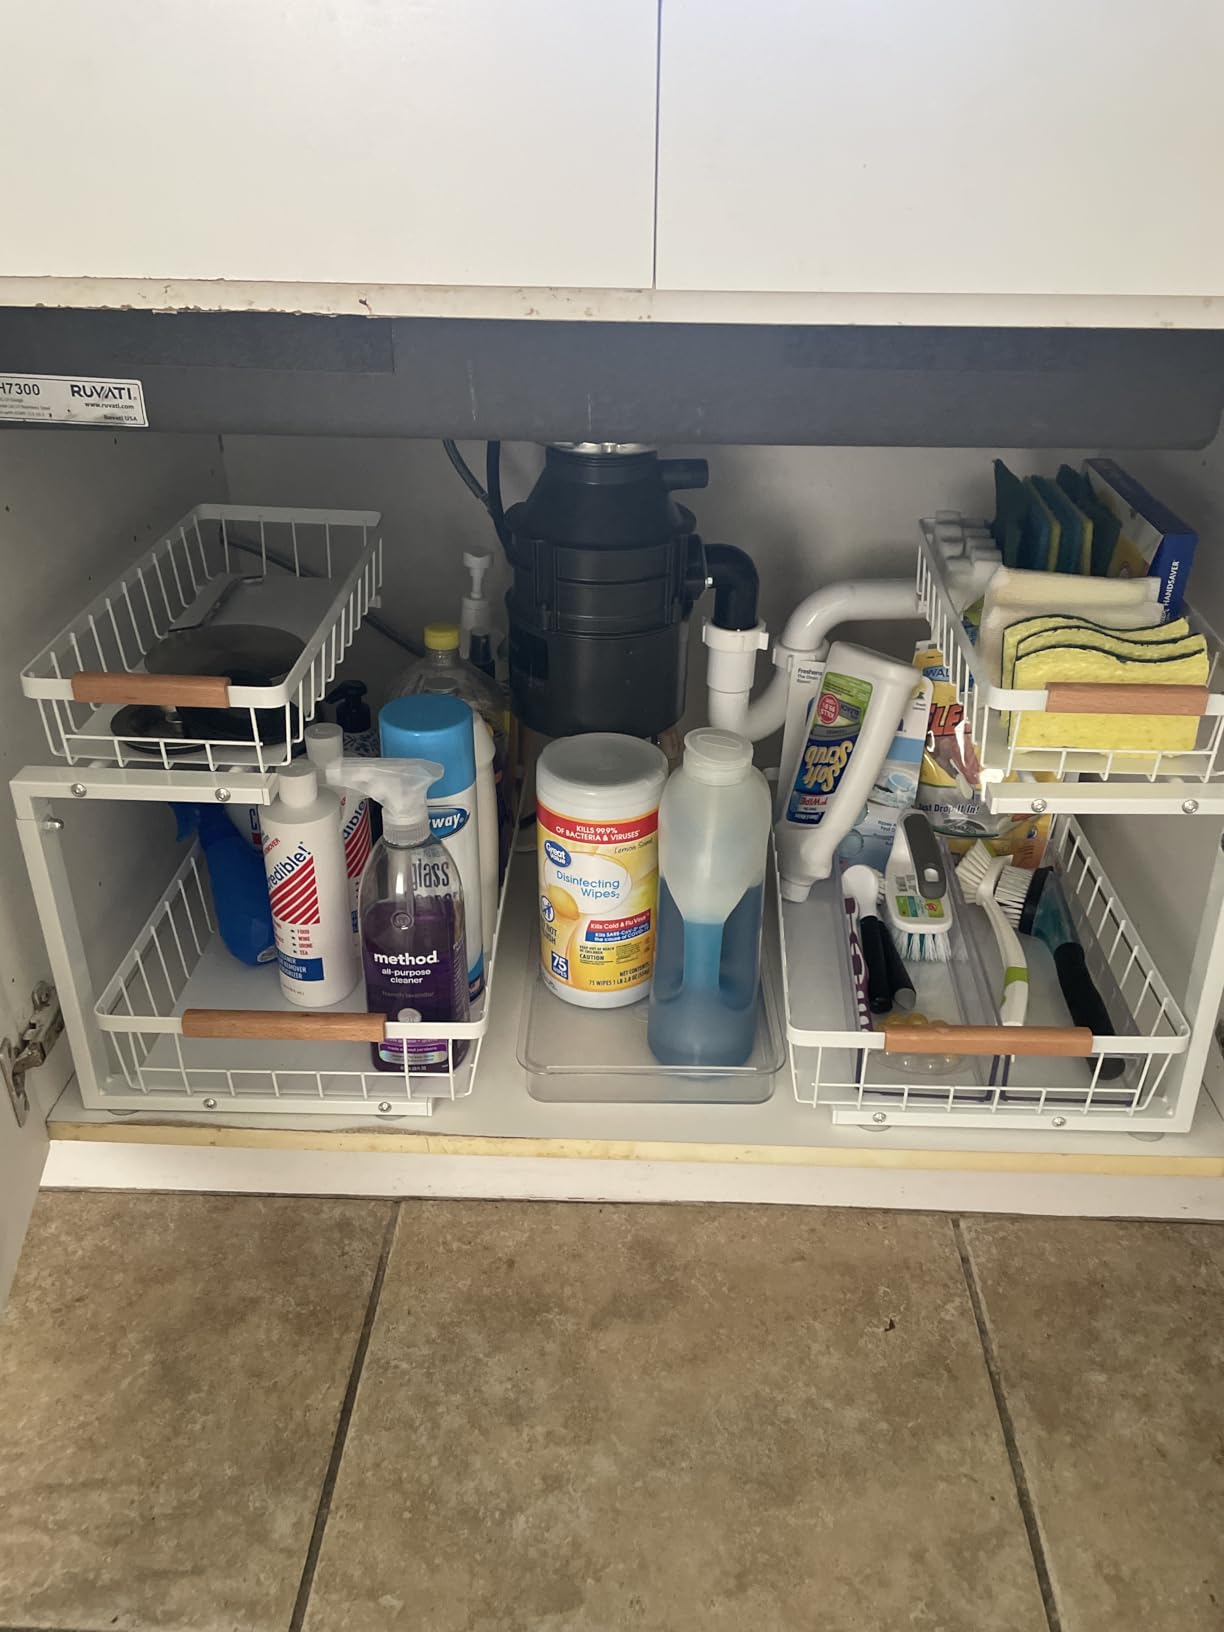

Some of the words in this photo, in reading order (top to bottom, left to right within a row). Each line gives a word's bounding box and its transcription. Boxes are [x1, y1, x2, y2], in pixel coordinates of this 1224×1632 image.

[70, 384, 132, 400] RUVATI
[85, 401, 135, 410] www.ruvati.com
[1163, 559, 1181, 607] HANDSAVER
[804, 740, 853, 769] Scrub
[802, 764, 840, 792] Soft
[966, 804, 980, 814] In!
[555, 826, 565, 834] OF
[566, 829, 601, 841] BACTERIA
[601, 834, 609, 842] &
[576, 825, 594, 834] KILLS
[595, 827, 618, 835] 99.9%
[545, 842, 566, 859] Great
[268, 845, 312, 890] redible!
[556, 870, 620, 890] Disinfecting
[552, 952, 568, 972] 75
[579, 953, 605, 961] CAUTION
[381, 968, 431, 977] all-purpose
[390, 976, 424, 984] cleaner
